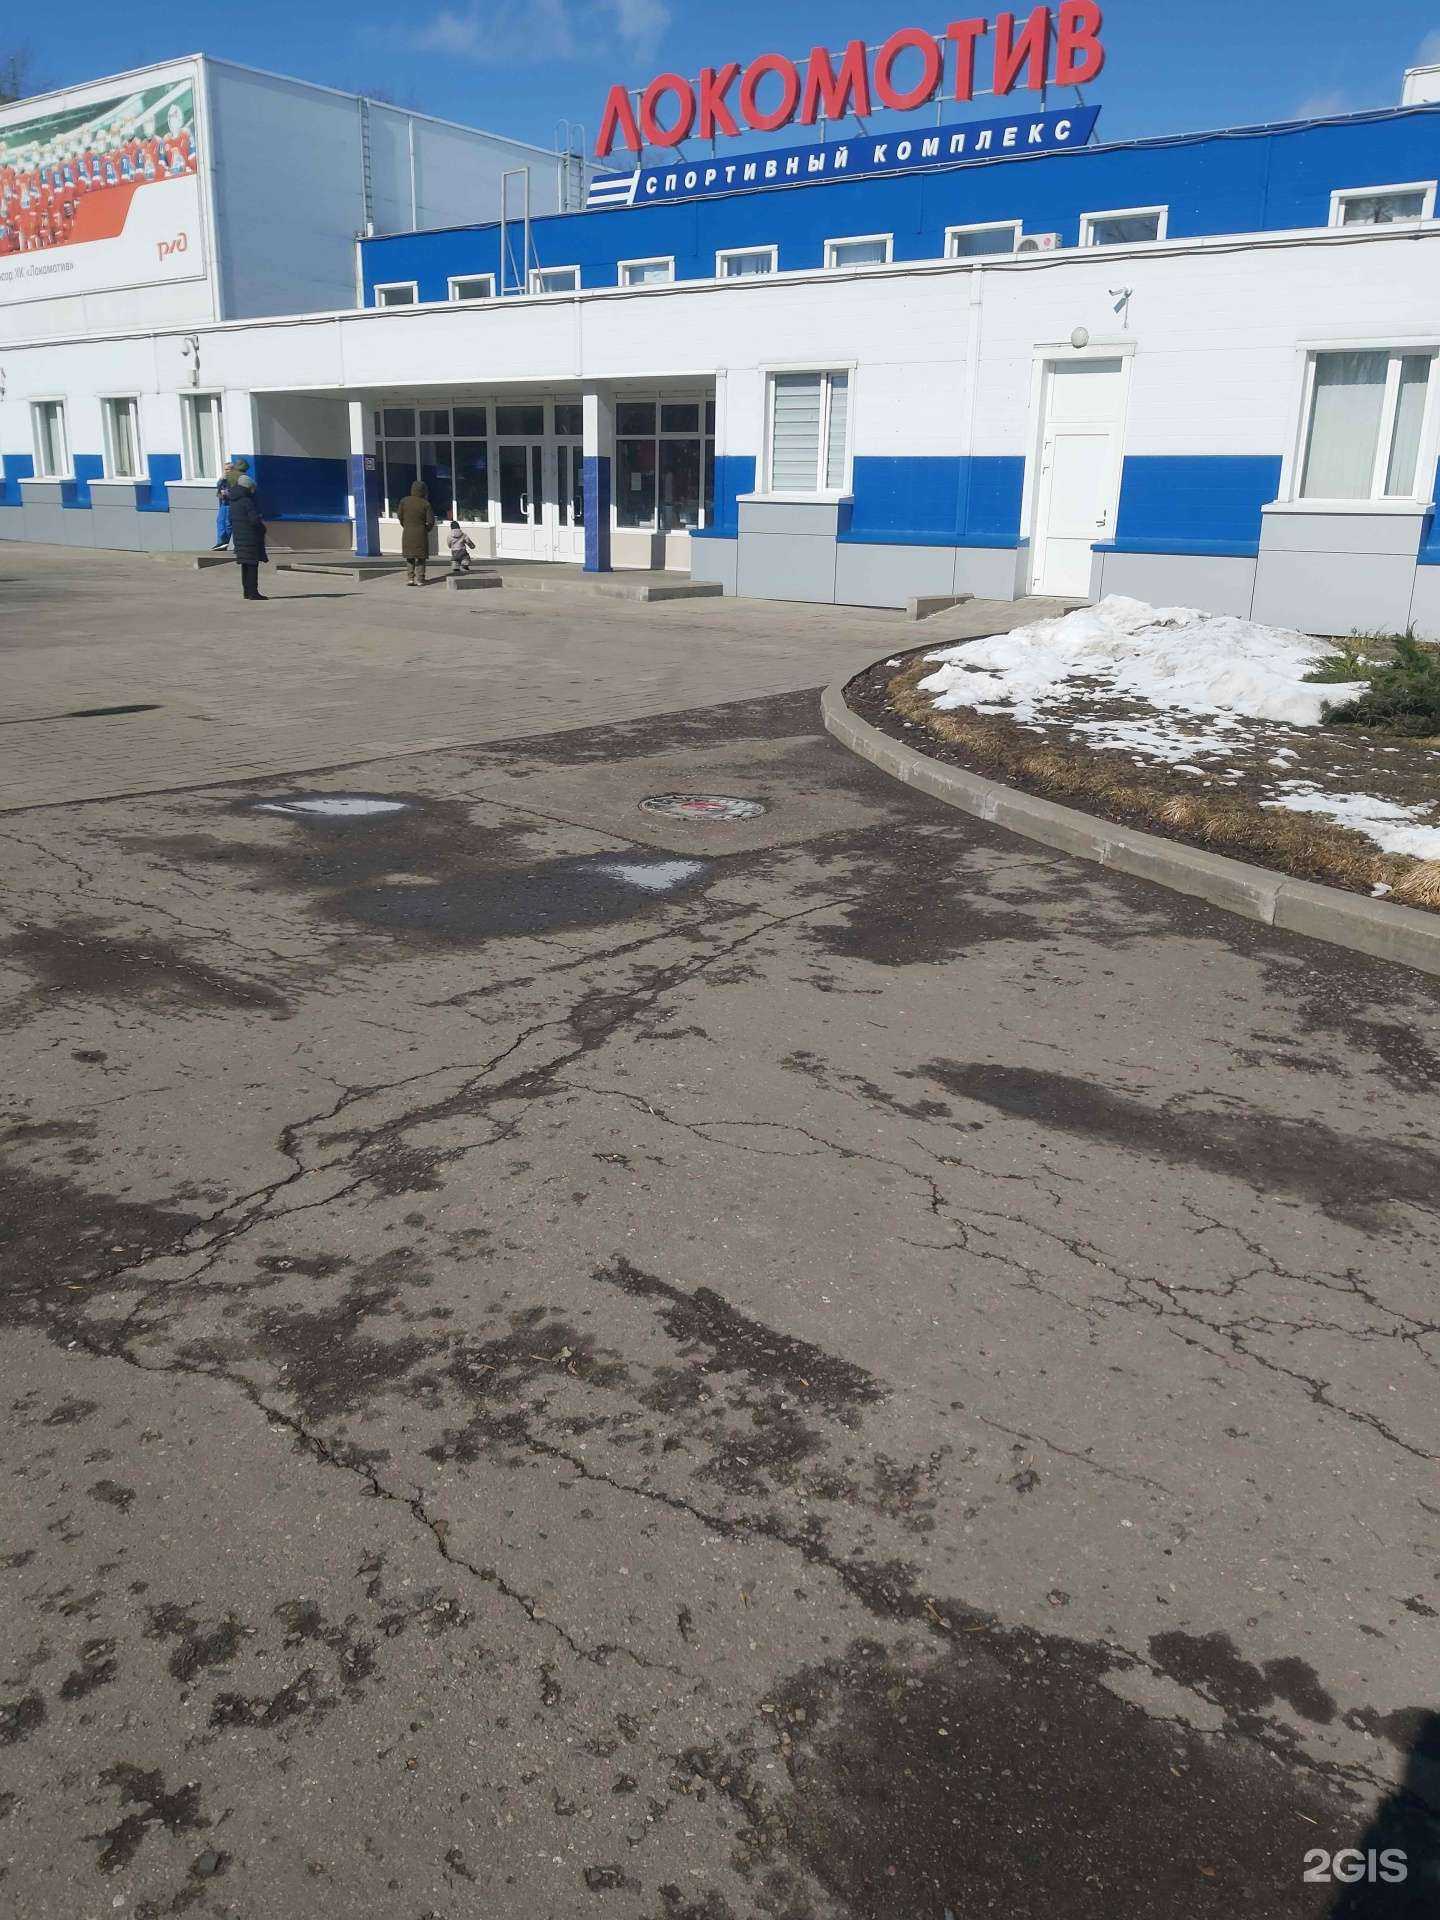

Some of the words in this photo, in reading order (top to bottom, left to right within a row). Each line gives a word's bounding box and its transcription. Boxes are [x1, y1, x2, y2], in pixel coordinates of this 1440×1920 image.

[595, 0, 1105, 158] ЛОКОМОТИВ
[645, 146, 848, 194] СПОРТИВНЫЙ
[873, 120, 1072, 164] КОМПЛЕКС
